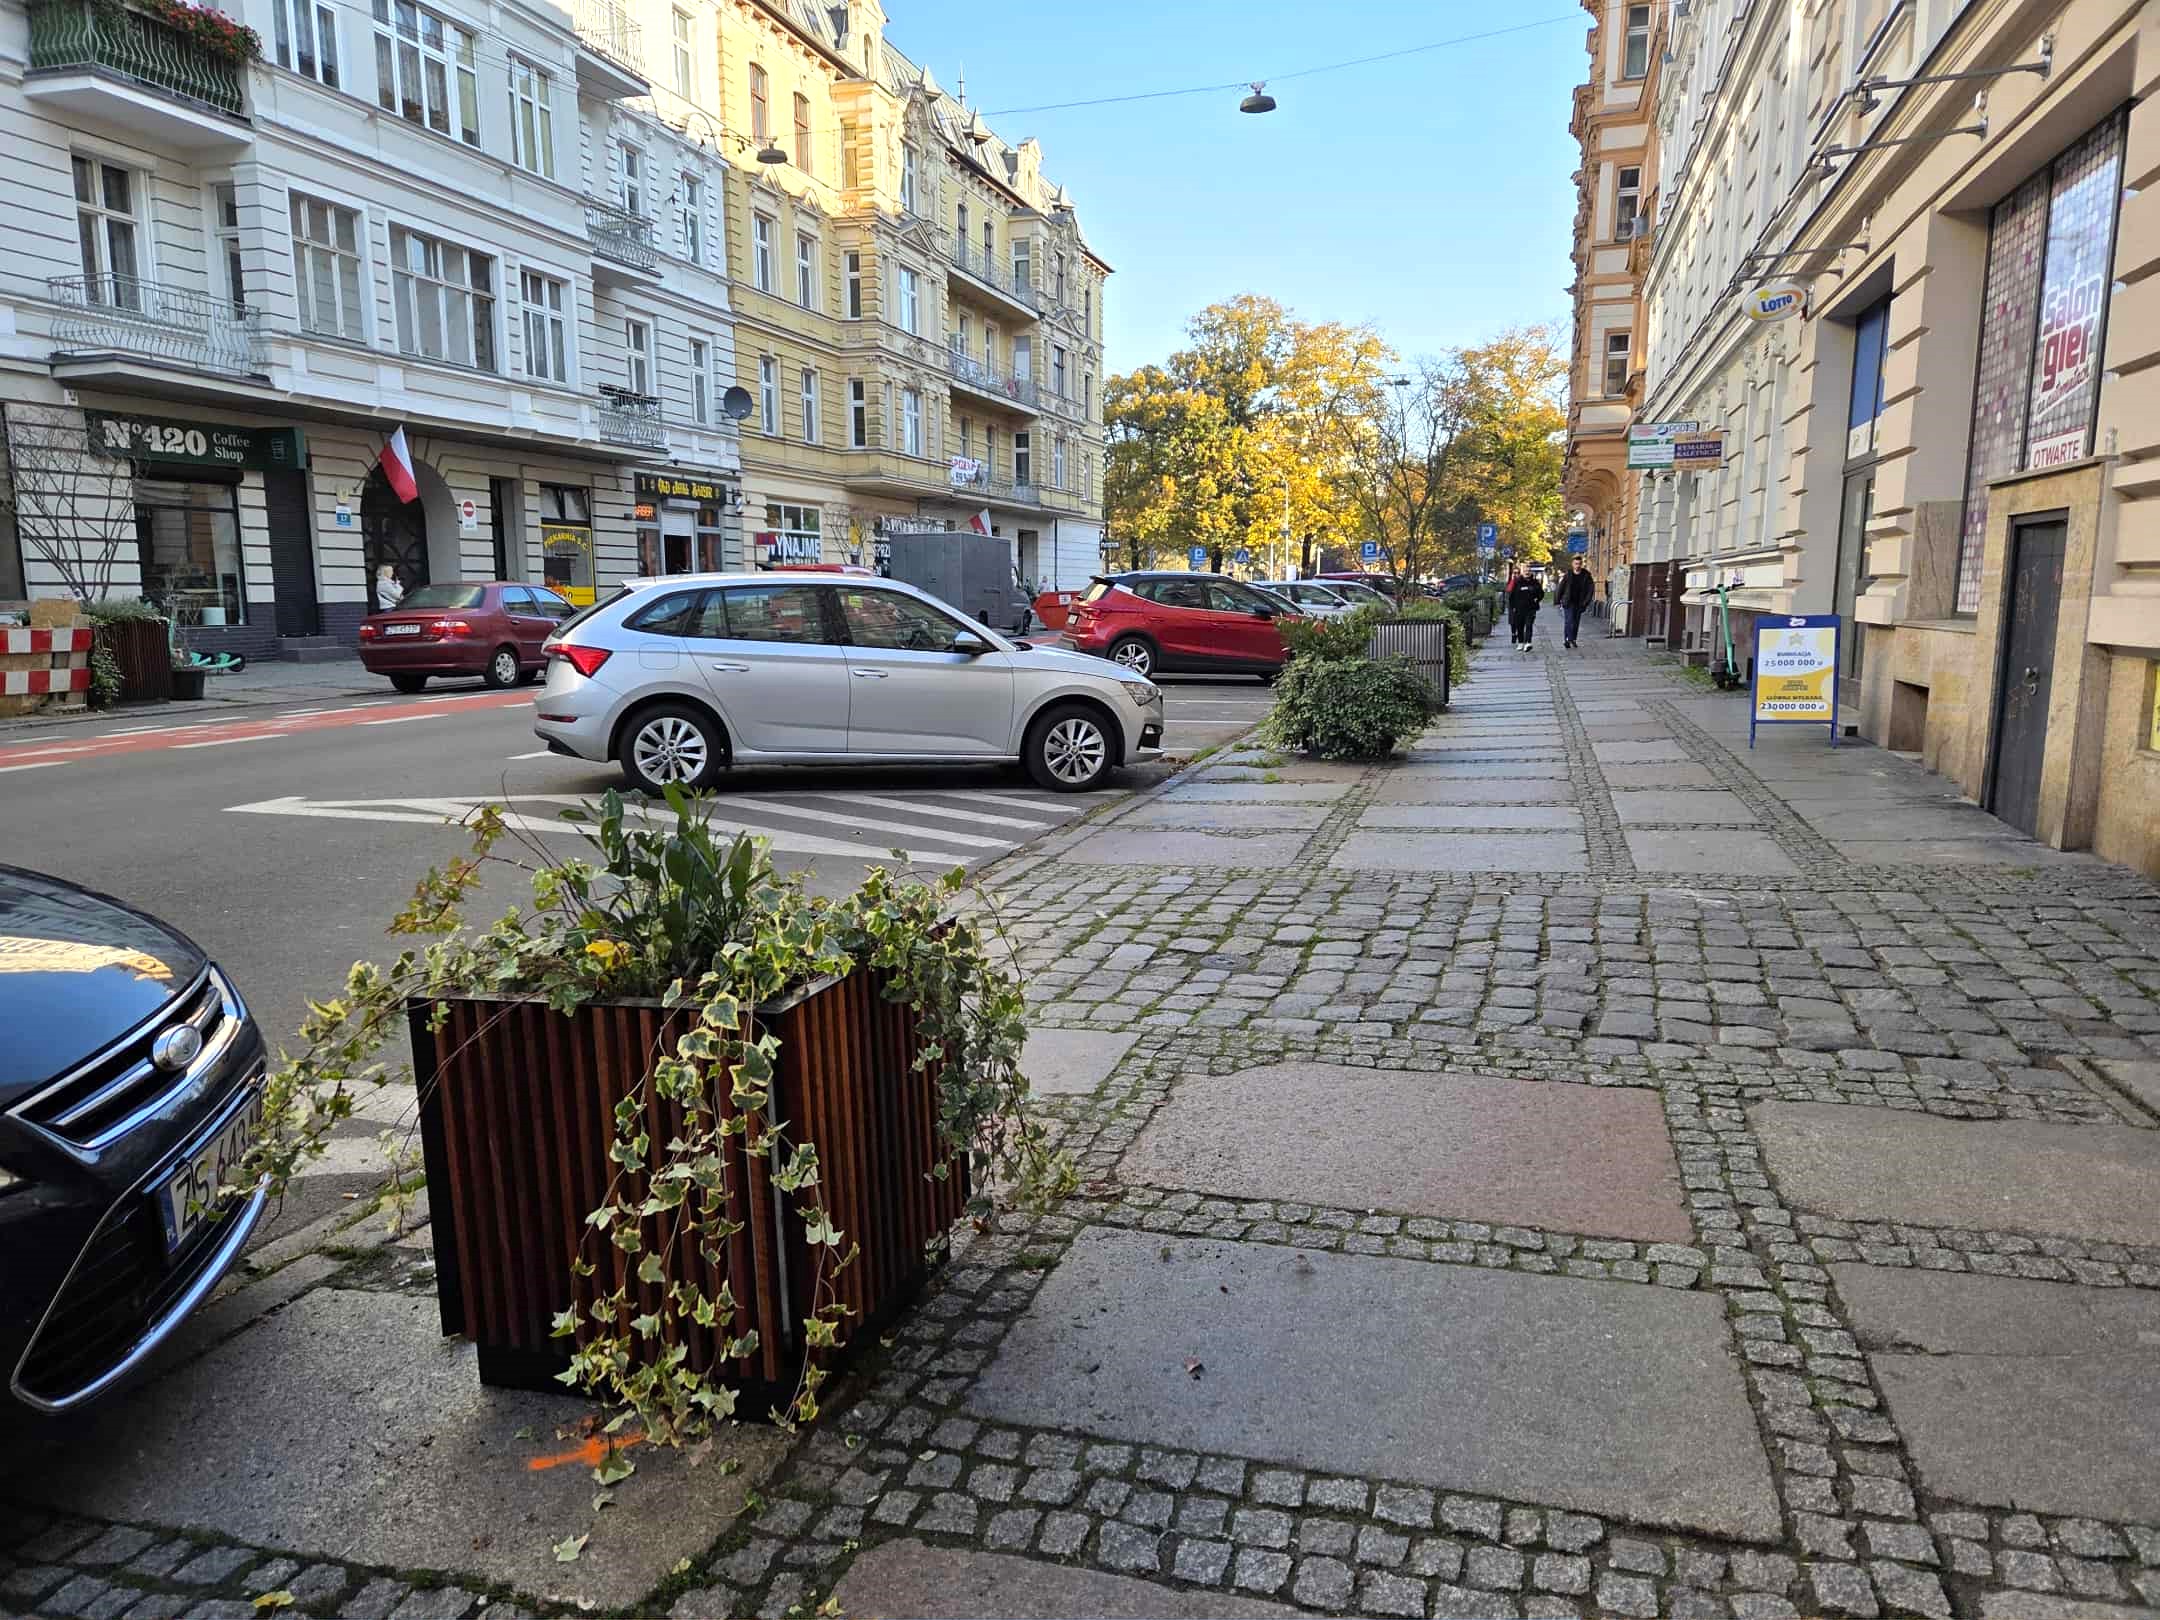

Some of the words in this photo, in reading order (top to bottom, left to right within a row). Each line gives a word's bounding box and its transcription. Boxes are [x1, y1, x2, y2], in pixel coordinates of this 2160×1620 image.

[1761, 295, 1793, 312] LOTTO
[2041, 317, 2095, 393] gier
[212, 432, 250, 448] Coffee
[215, 447, 245, 463] Shop
[2033, 439, 2080, 468] OTWARTE
[176, 1159, 209, 1233] ZS
